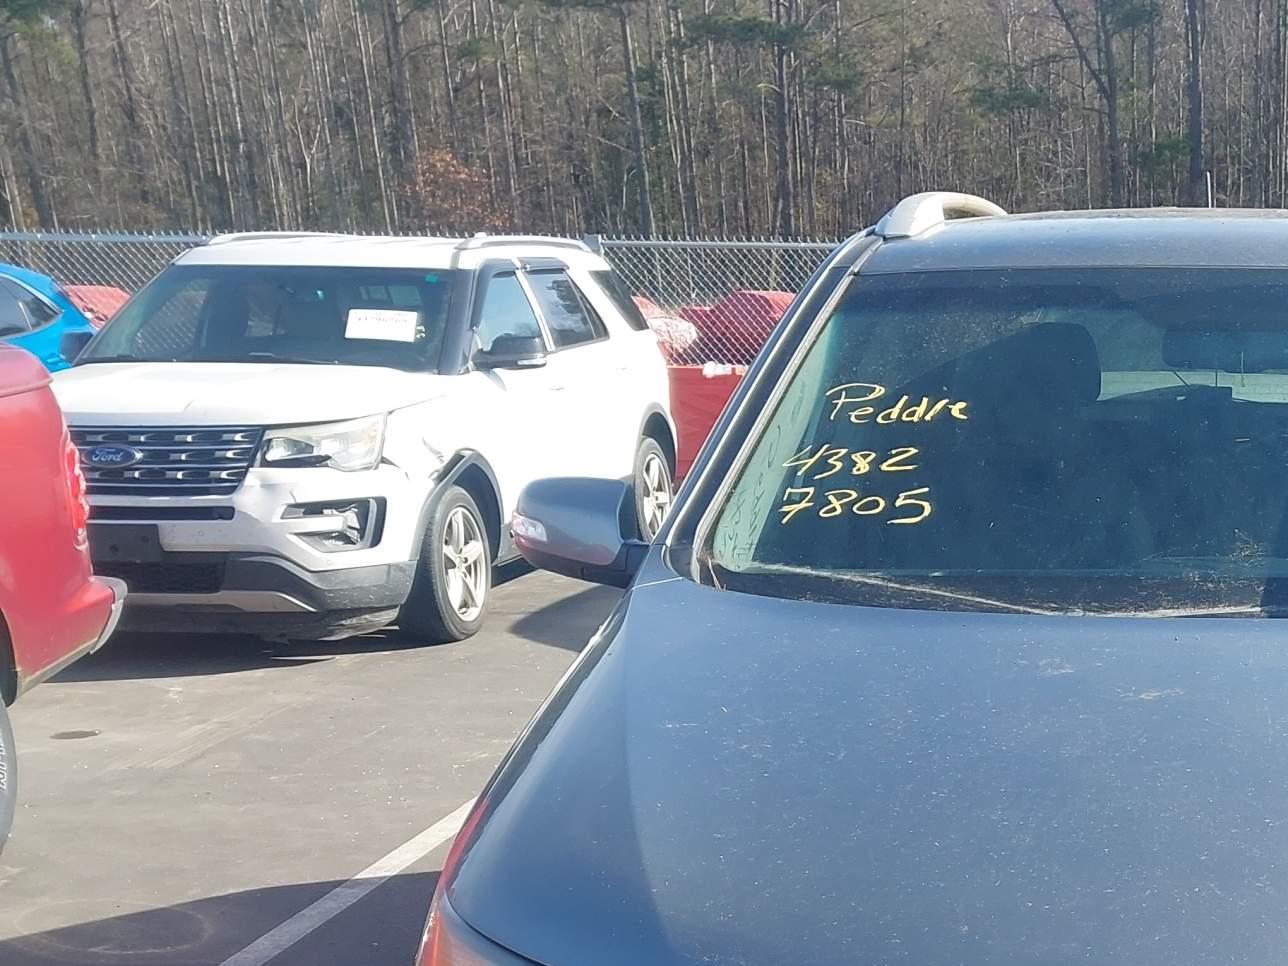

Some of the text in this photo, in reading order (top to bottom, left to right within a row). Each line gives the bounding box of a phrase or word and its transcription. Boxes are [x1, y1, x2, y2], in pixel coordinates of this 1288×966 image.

[92, 448, 124, 461] Ford
[782, 444, 919, 479] 4382
[778, 487, 933, 525] 7805
